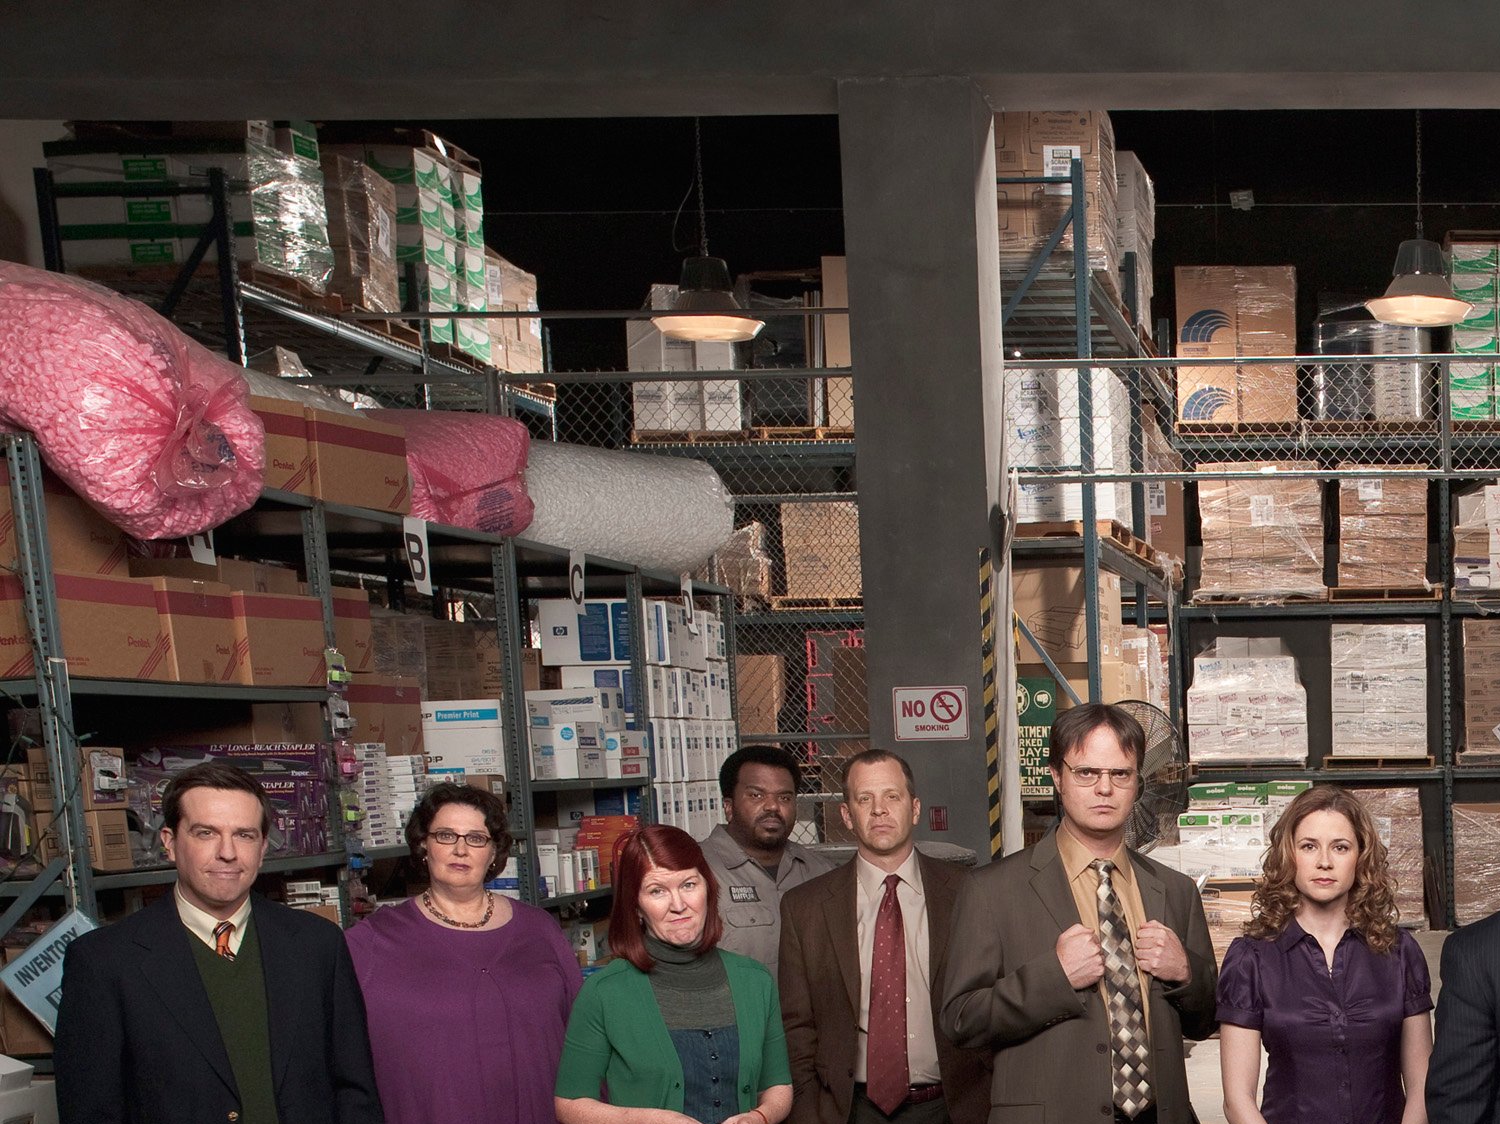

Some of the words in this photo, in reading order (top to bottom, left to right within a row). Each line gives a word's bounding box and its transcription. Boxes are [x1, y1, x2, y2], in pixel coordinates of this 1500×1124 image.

[273, 458, 295, 471] Pentel
[405, 531, 426, 582] B
[571, 563, 583, 605] C
[127, 635, 151, 649] Pentel
[437, 711, 462, 720] Premier
[463, 711, 480, 719] Print
[901, 700, 926, 718] NO
[914, 724, 950, 732] SMOKING
[228, 743, 281, 752] LONG-REACH
[281, 743, 316, 751] STAPLER
[1025, 766, 1052, 776] TIME
[260, 782, 295, 790] STAPLER
[14, 926, 79, 988] INVENTORY
